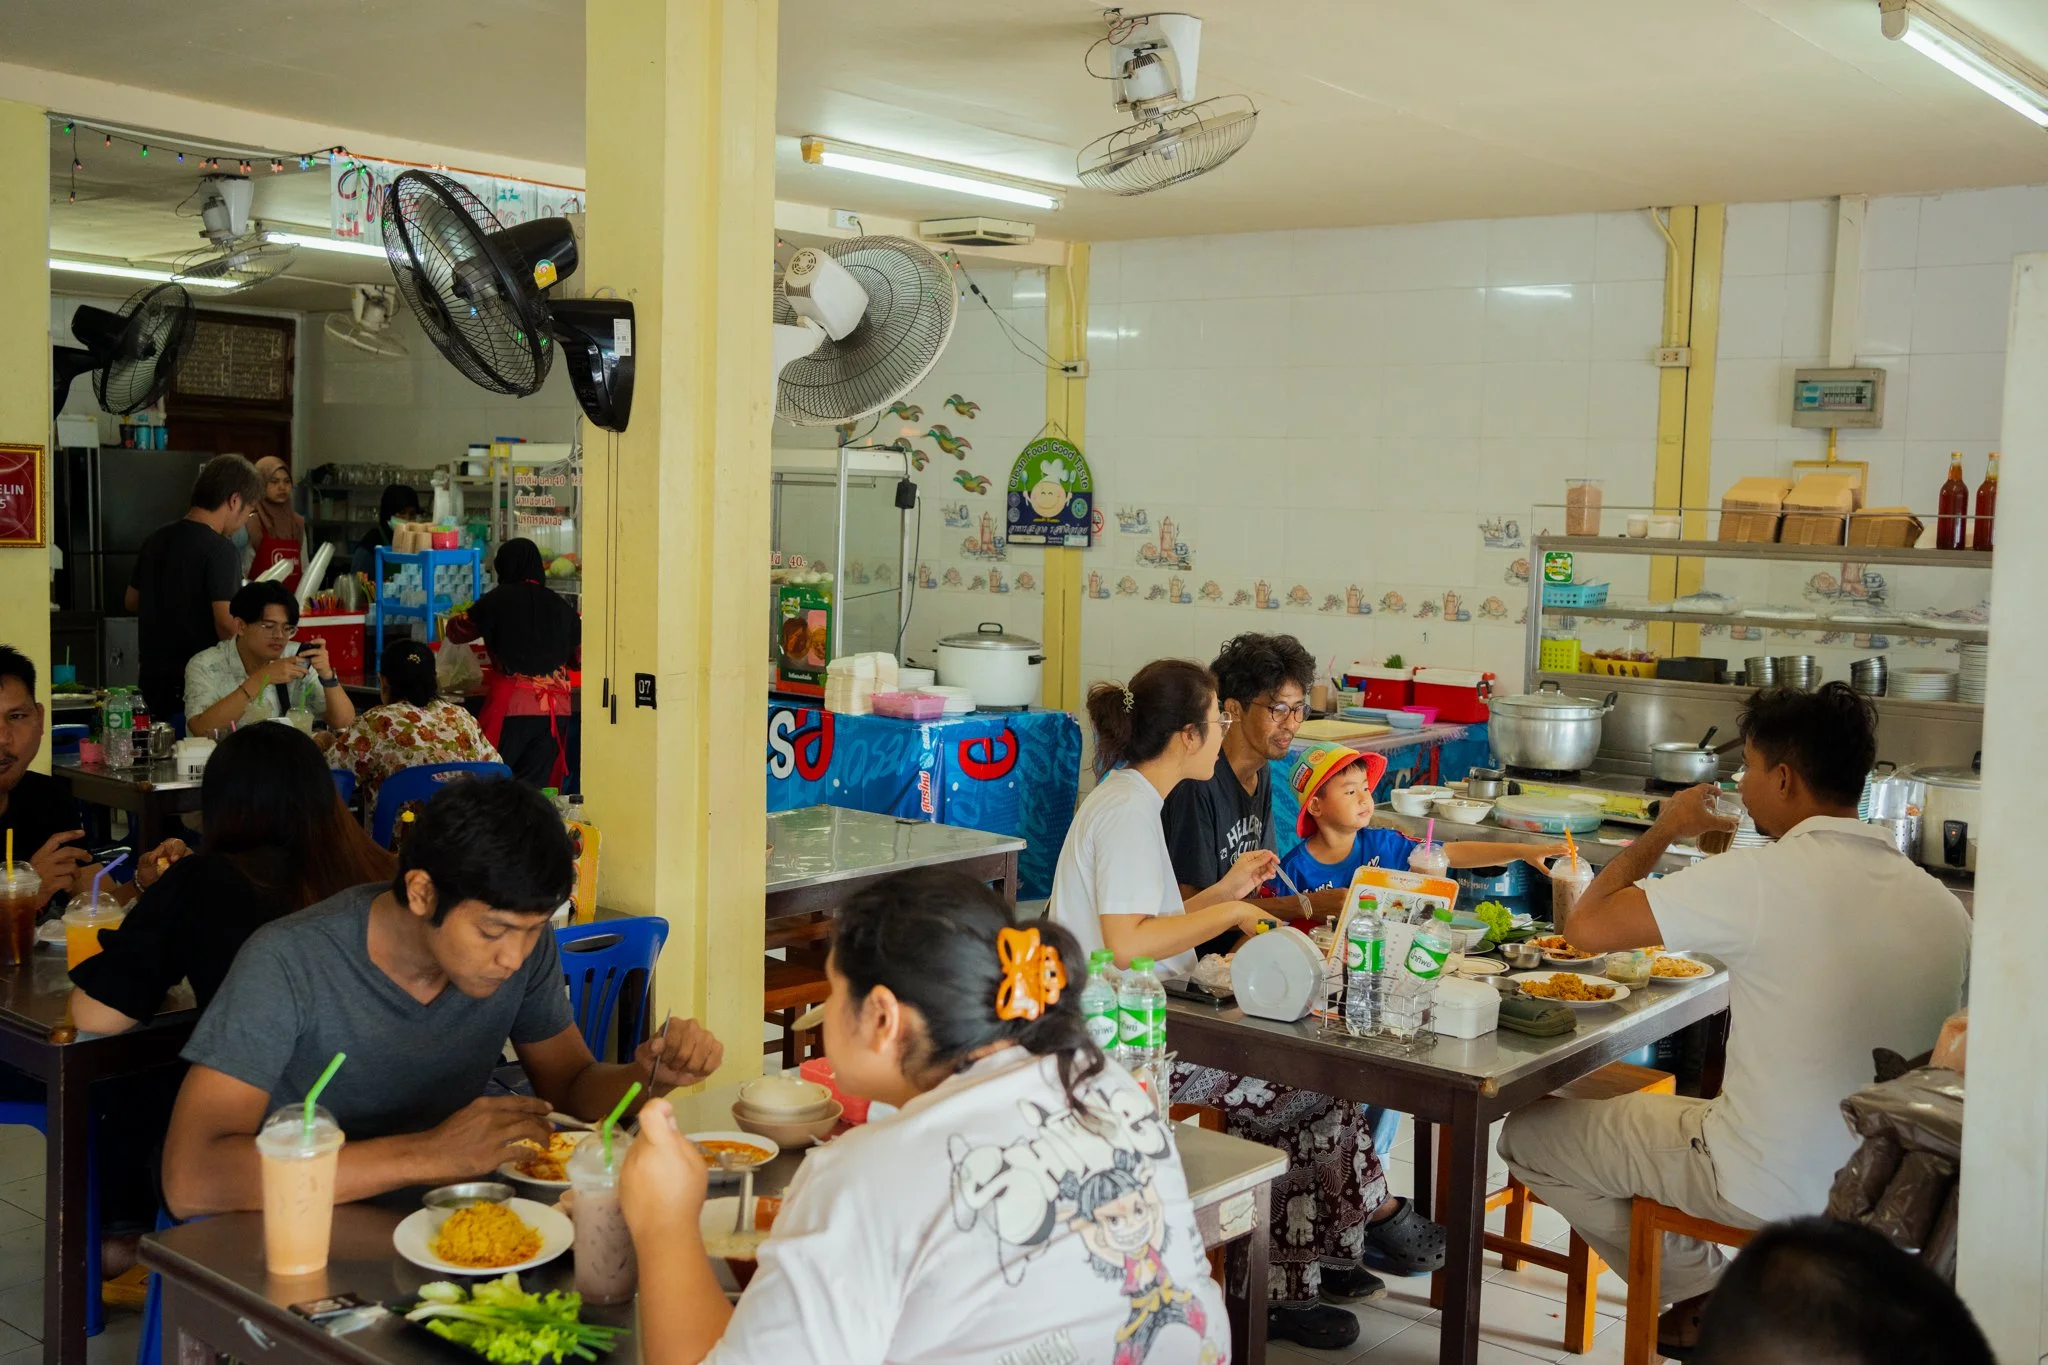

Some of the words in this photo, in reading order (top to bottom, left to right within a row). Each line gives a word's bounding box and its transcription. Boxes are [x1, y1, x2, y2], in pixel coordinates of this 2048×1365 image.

[1009, 457, 1026, 488] Clean
[1024, 442, 1048, 460] Food
[1051, 441, 1075, 460] Good
[1074, 455, 1089, 489] Taste
[639, 680, 651, 694] 07
